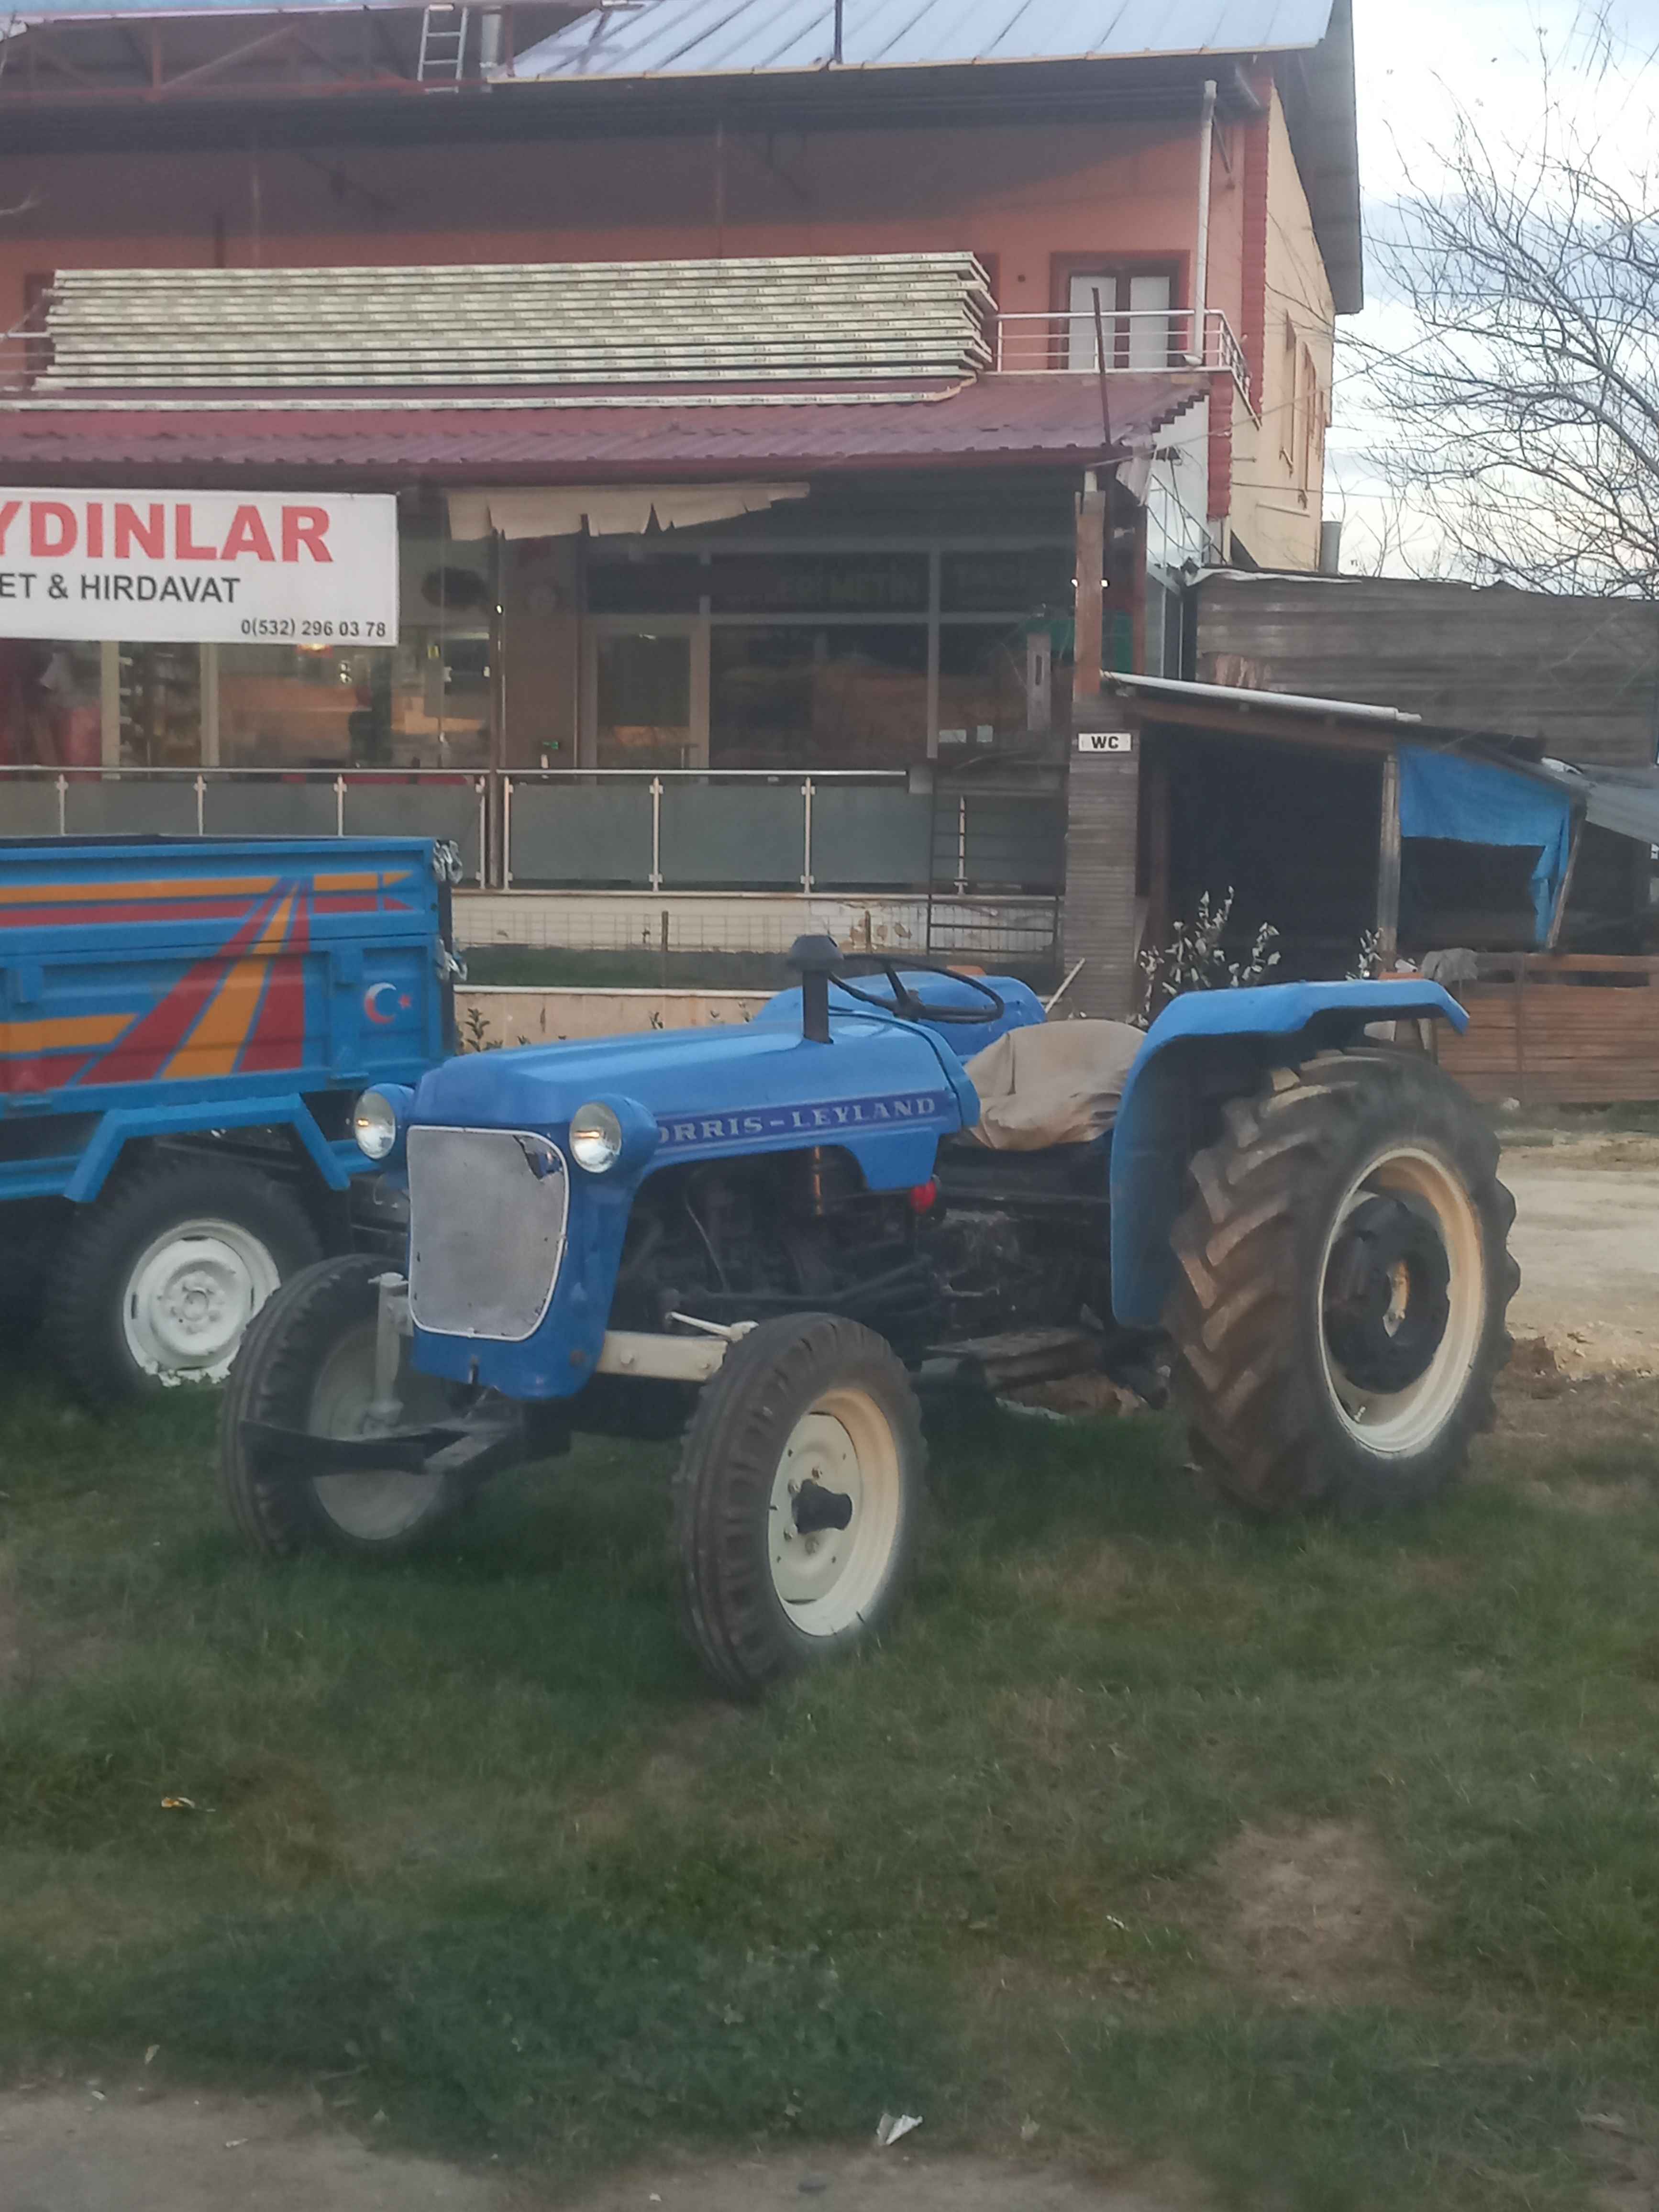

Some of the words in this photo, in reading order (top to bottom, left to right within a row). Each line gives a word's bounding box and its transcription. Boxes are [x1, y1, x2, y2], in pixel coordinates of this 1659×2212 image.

[48, 574, 68, 599] &
[80, 574, 241, 603] HIRDAVAT
[241, 618, 296, 637] 0(532)
[301, 620, 333, 636] 296
[339, 621, 359, 636] 03
[365, 621, 386, 637] 78
[1091, 736, 1119, 749] WC
